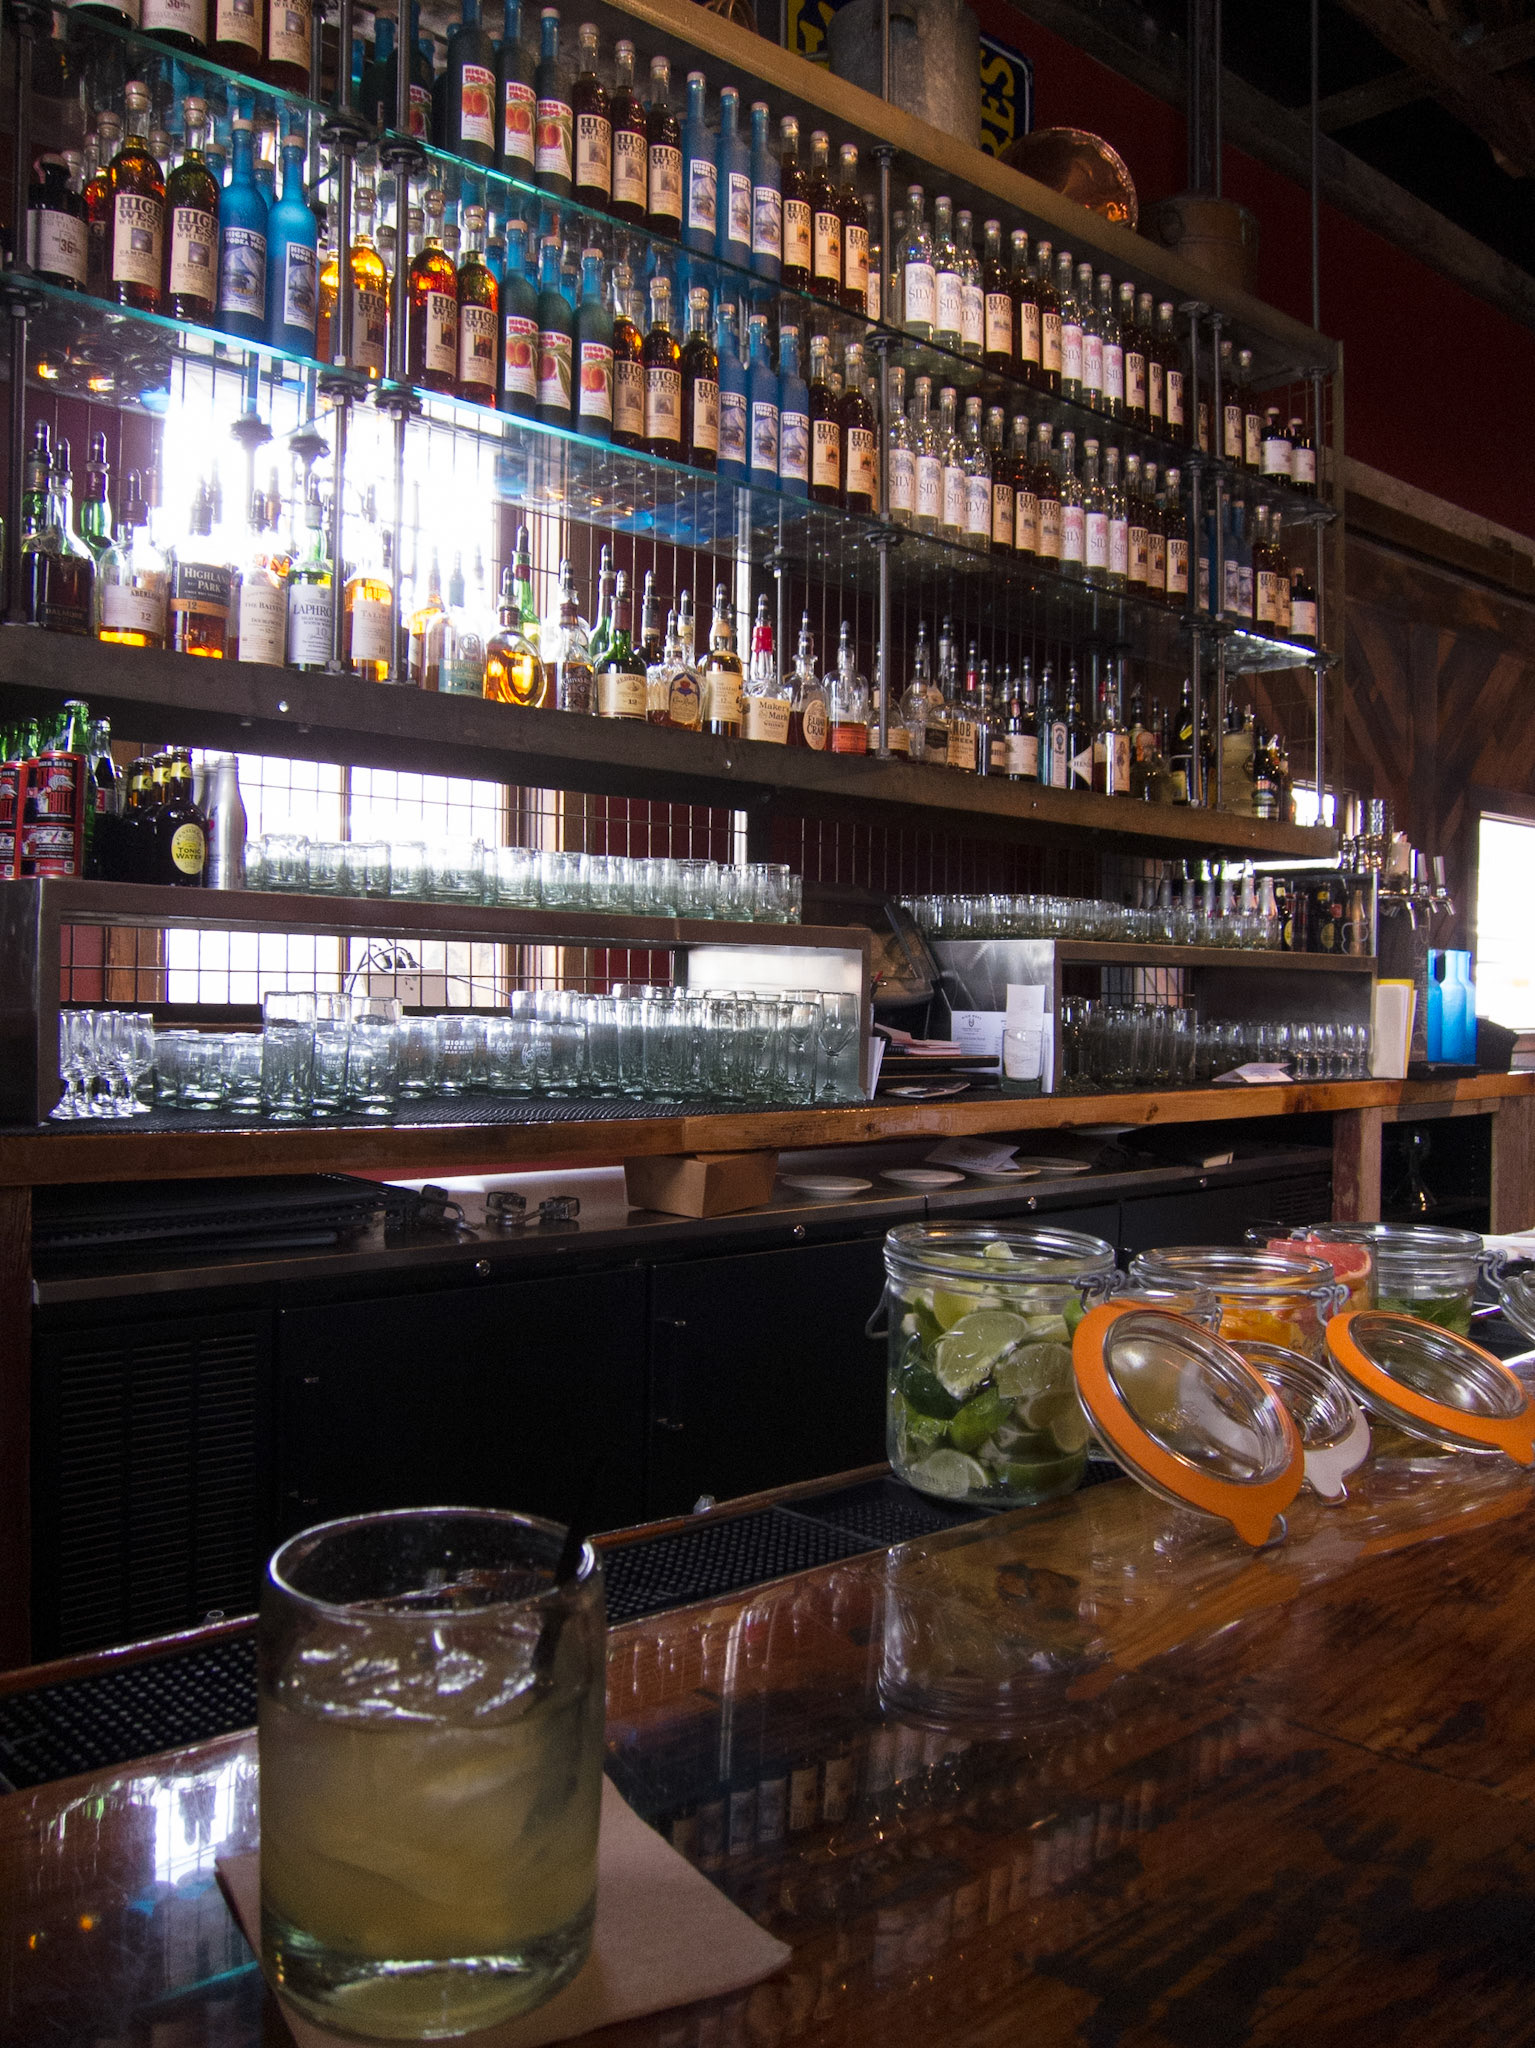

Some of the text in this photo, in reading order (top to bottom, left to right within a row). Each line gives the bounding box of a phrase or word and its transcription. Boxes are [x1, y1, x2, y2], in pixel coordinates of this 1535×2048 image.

[225, 231, 248, 239] HIGH
[60, 238, 73, 254] 36
[698, 381, 718, 393] HIG
[817, 423, 839, 435] HIG
[852, 431, 873, 442] HIG
[197, 580, 222, 593] PARK
[186, 601, 198, 611] 12
[293, 603, 332, 618] LAPHRO
[141, 611, 151, 622] 12
[316, 626, 328, 637] 10
[768, 712, 789, 722] Mark
